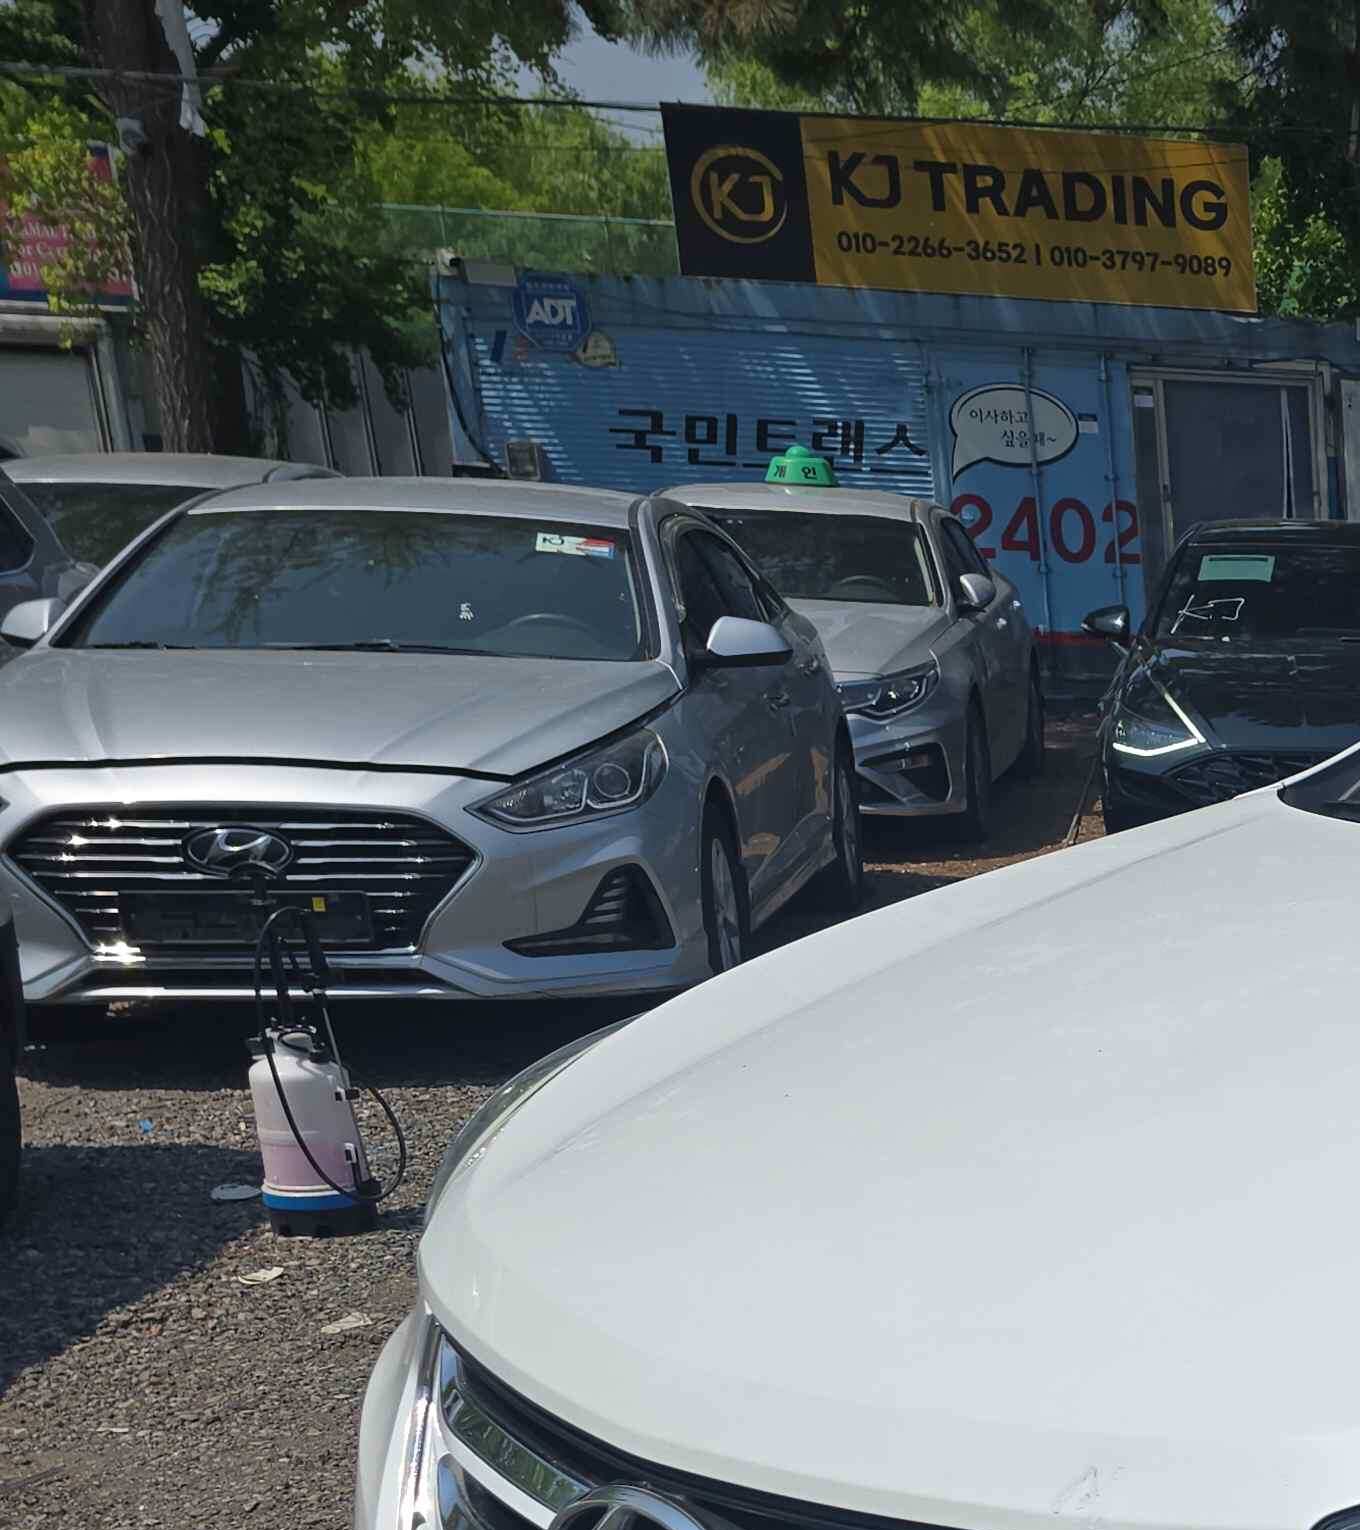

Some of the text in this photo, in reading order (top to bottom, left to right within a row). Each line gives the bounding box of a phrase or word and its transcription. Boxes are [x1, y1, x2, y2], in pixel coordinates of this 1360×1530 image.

[709, 171, 776, 223] KJ
[828, 150, 1229, 232] KJ TRADING
[837, 230, 1026, 266] 010-2266-3652
[1049, 246, 1232, 278] 010-3797-9089
[526, 297, 576, 325] ADT
[969, 407, 1031, 425] 이사하고
[951, 494, 1142, 565] 2402
